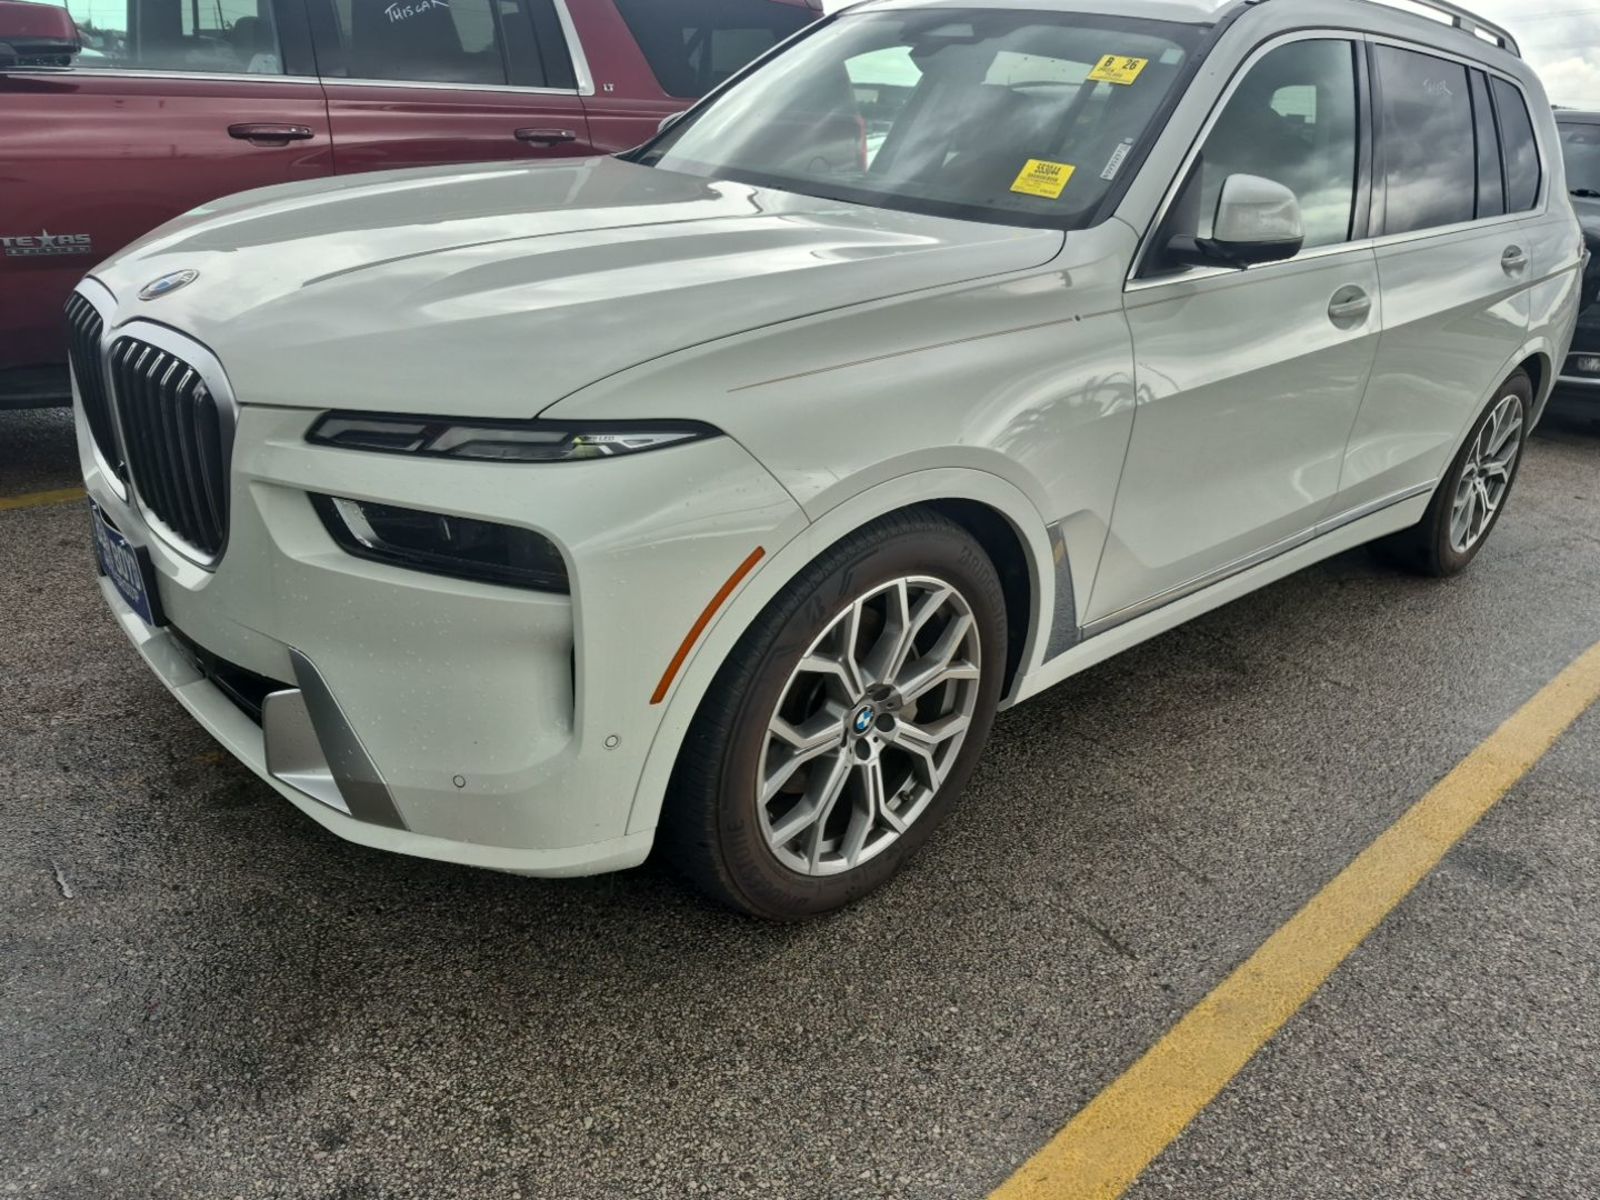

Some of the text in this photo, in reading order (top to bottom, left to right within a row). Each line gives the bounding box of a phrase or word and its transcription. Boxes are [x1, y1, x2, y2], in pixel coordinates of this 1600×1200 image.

[384, 2, 414, 22] THIS
[1122, 58, 1139, 71] 26
[603, 83, 615, 92] LT
